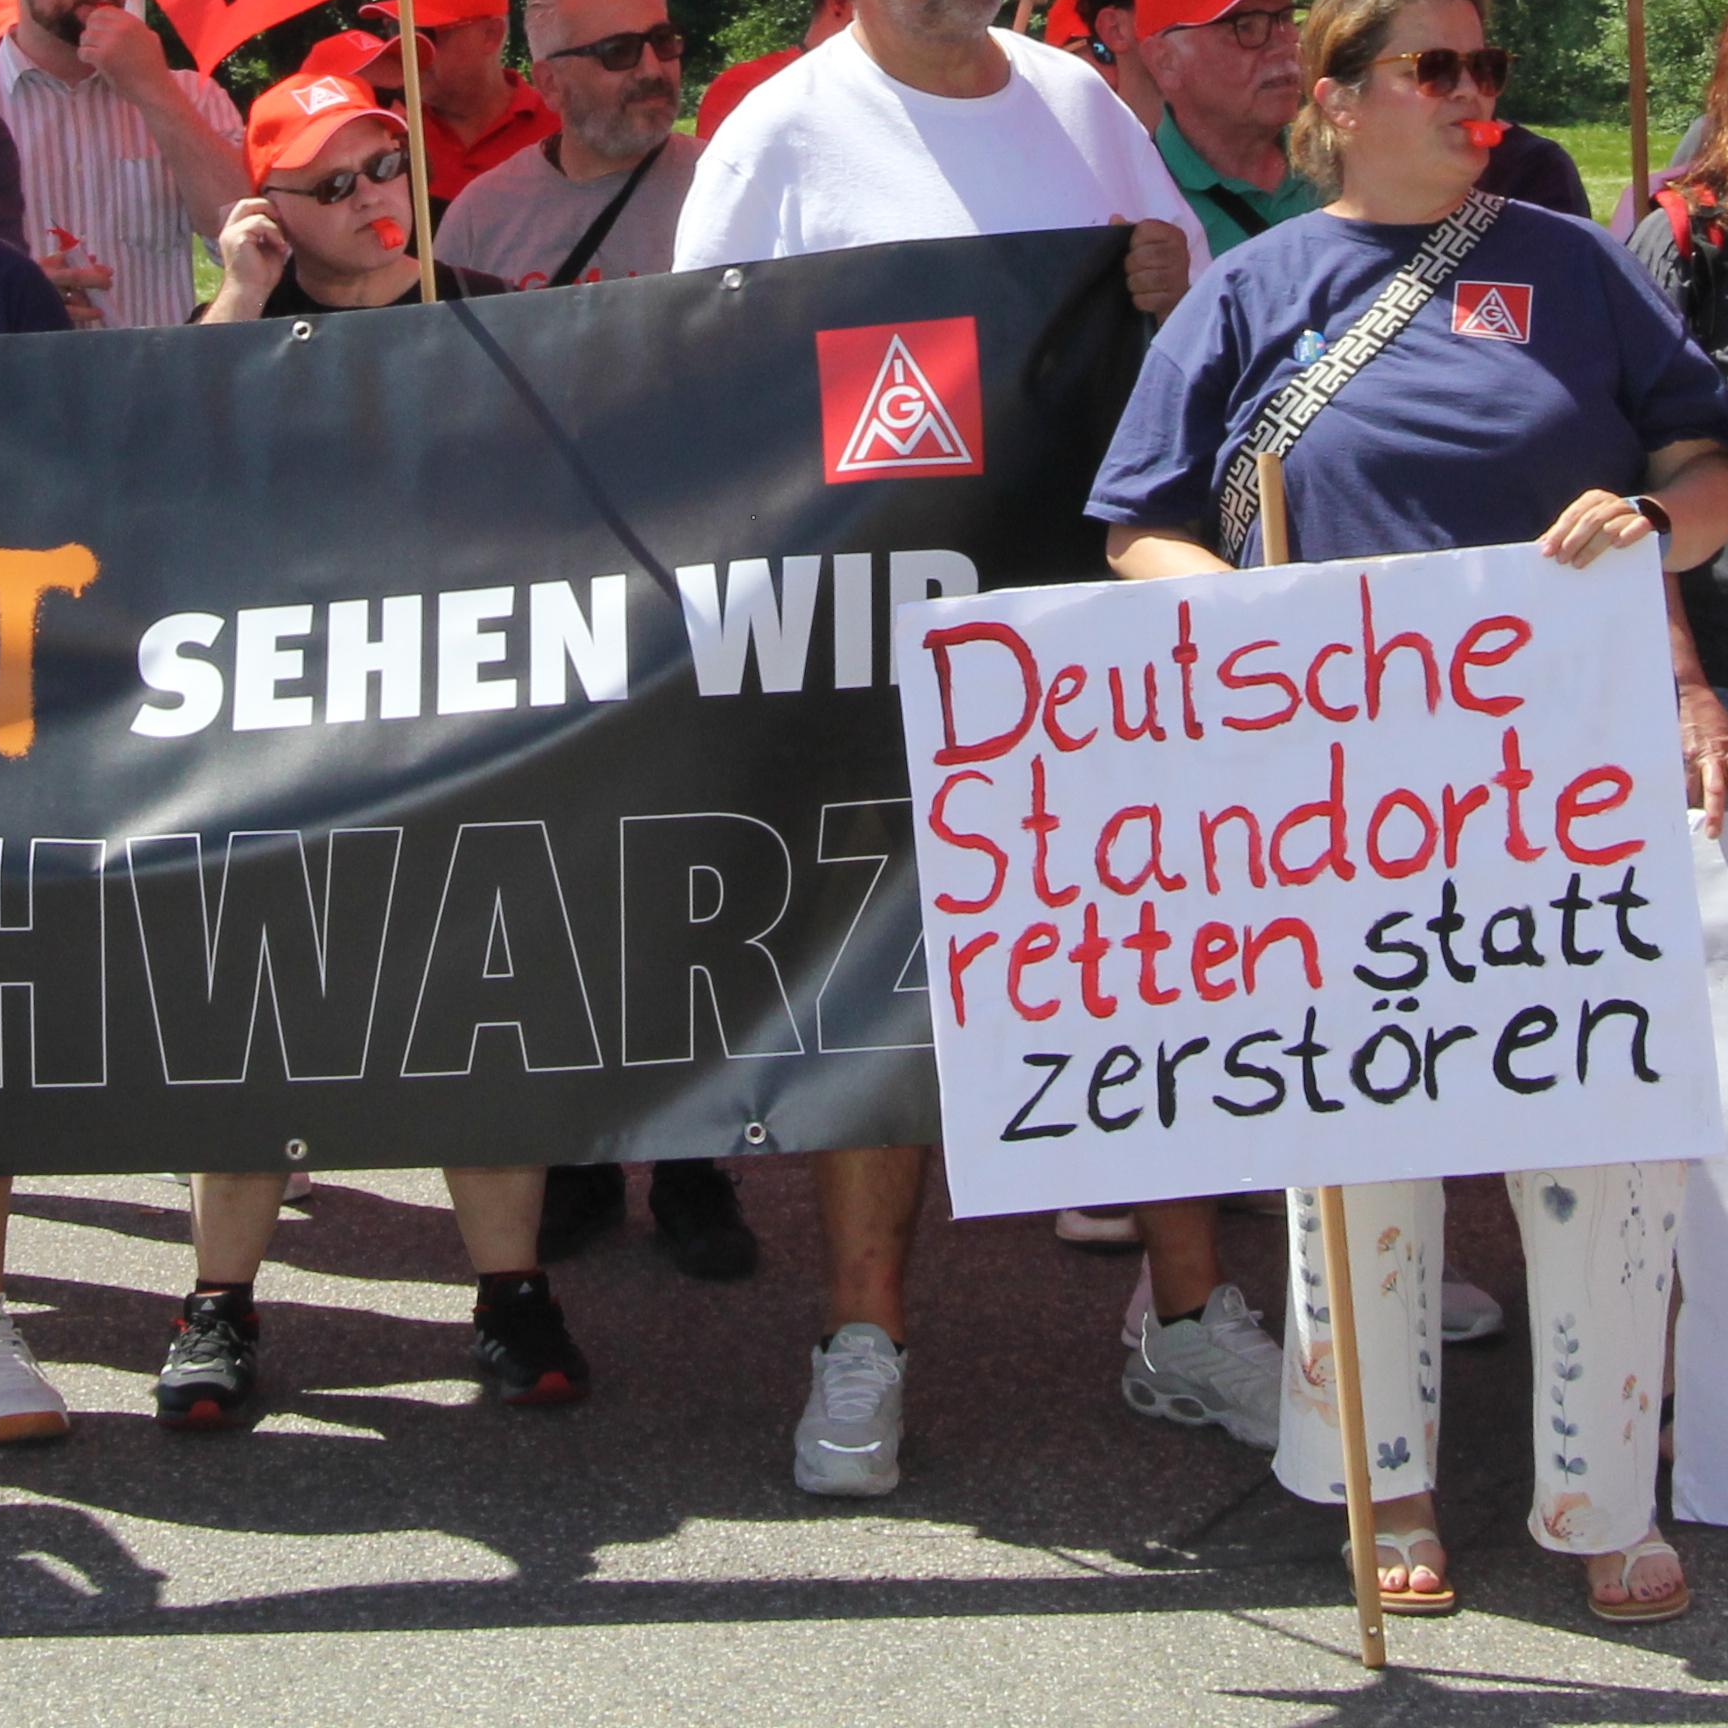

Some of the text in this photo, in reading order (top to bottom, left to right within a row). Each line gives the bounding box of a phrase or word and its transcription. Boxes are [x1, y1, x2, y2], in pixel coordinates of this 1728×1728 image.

[130, 574, 629, 738] SEHEN
[924, 573, 1534, 766] Deutsche
[928, 726, 1647, 914] Standorte
[947, 866, 1663, 1028] retten statt
[999, 997, 1662, 1142] zerstören
